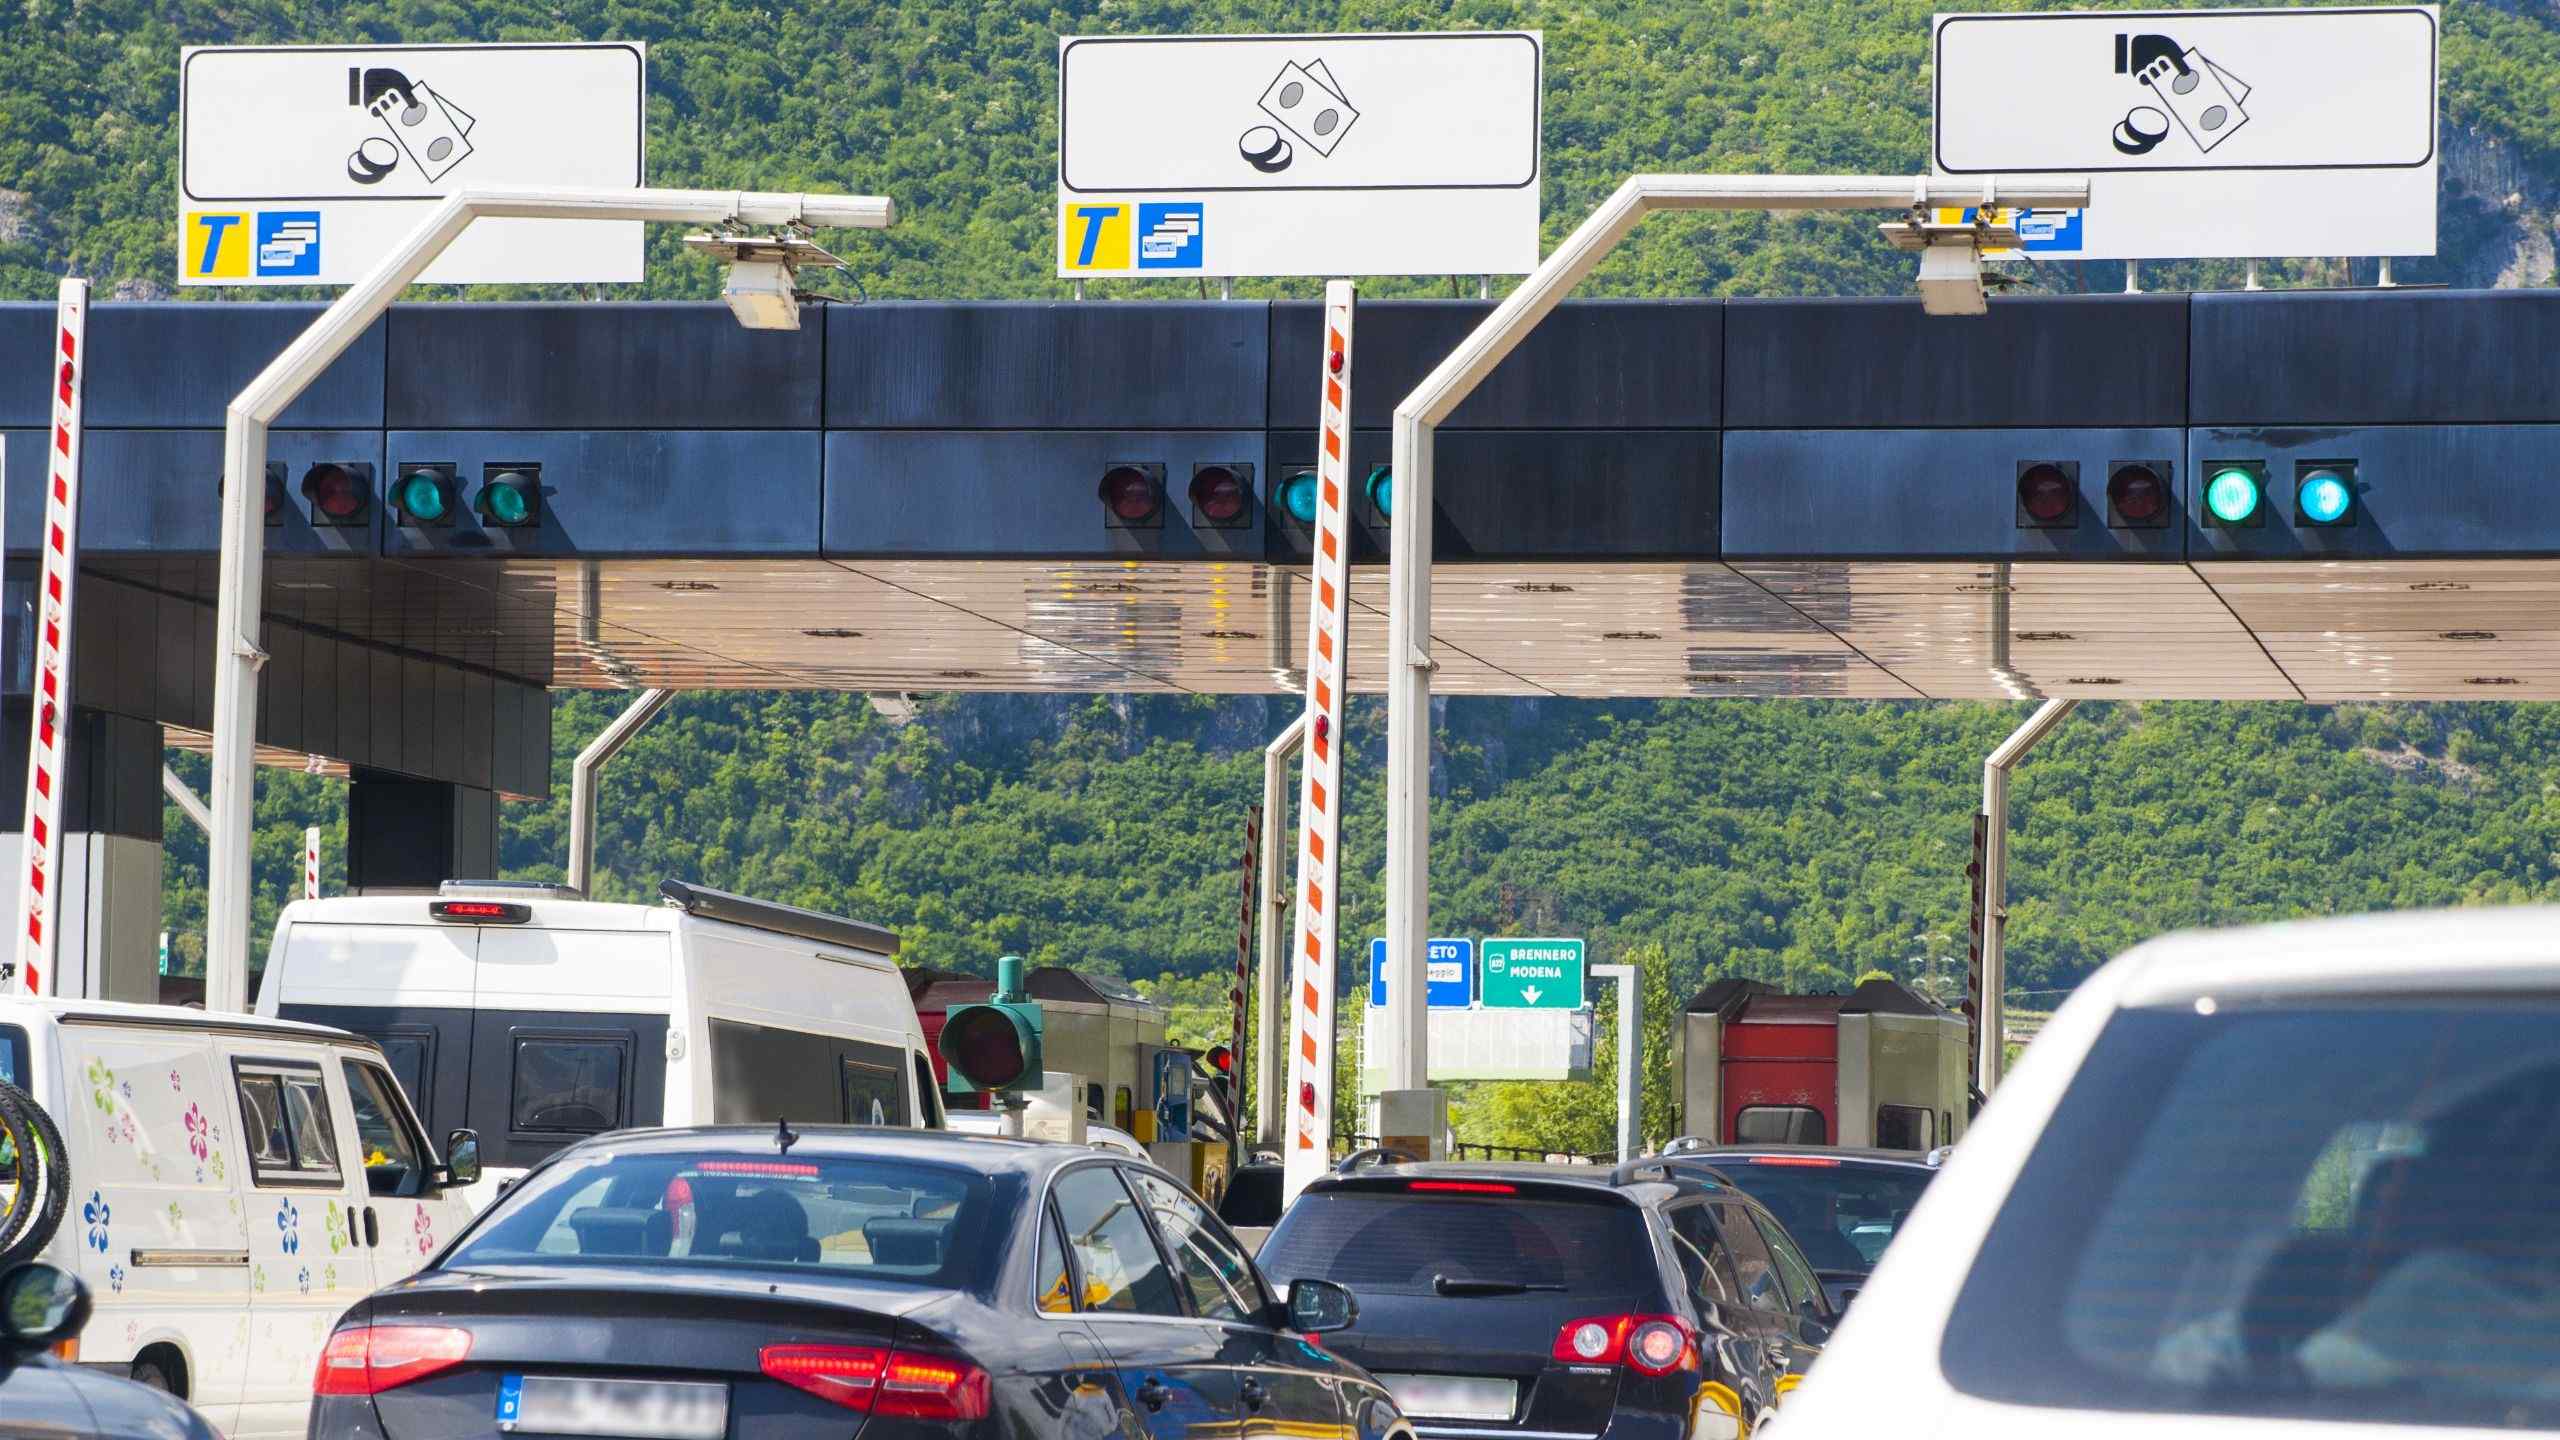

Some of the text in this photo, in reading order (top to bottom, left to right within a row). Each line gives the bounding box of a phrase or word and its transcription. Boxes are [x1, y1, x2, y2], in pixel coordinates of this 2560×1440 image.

[199, 216, 241, 273] T
[1077, 207, 1120, 266] T
[1509, 966, 1562, 978] MODENA
[1510, 948, 1577, 961] BRENNERO
